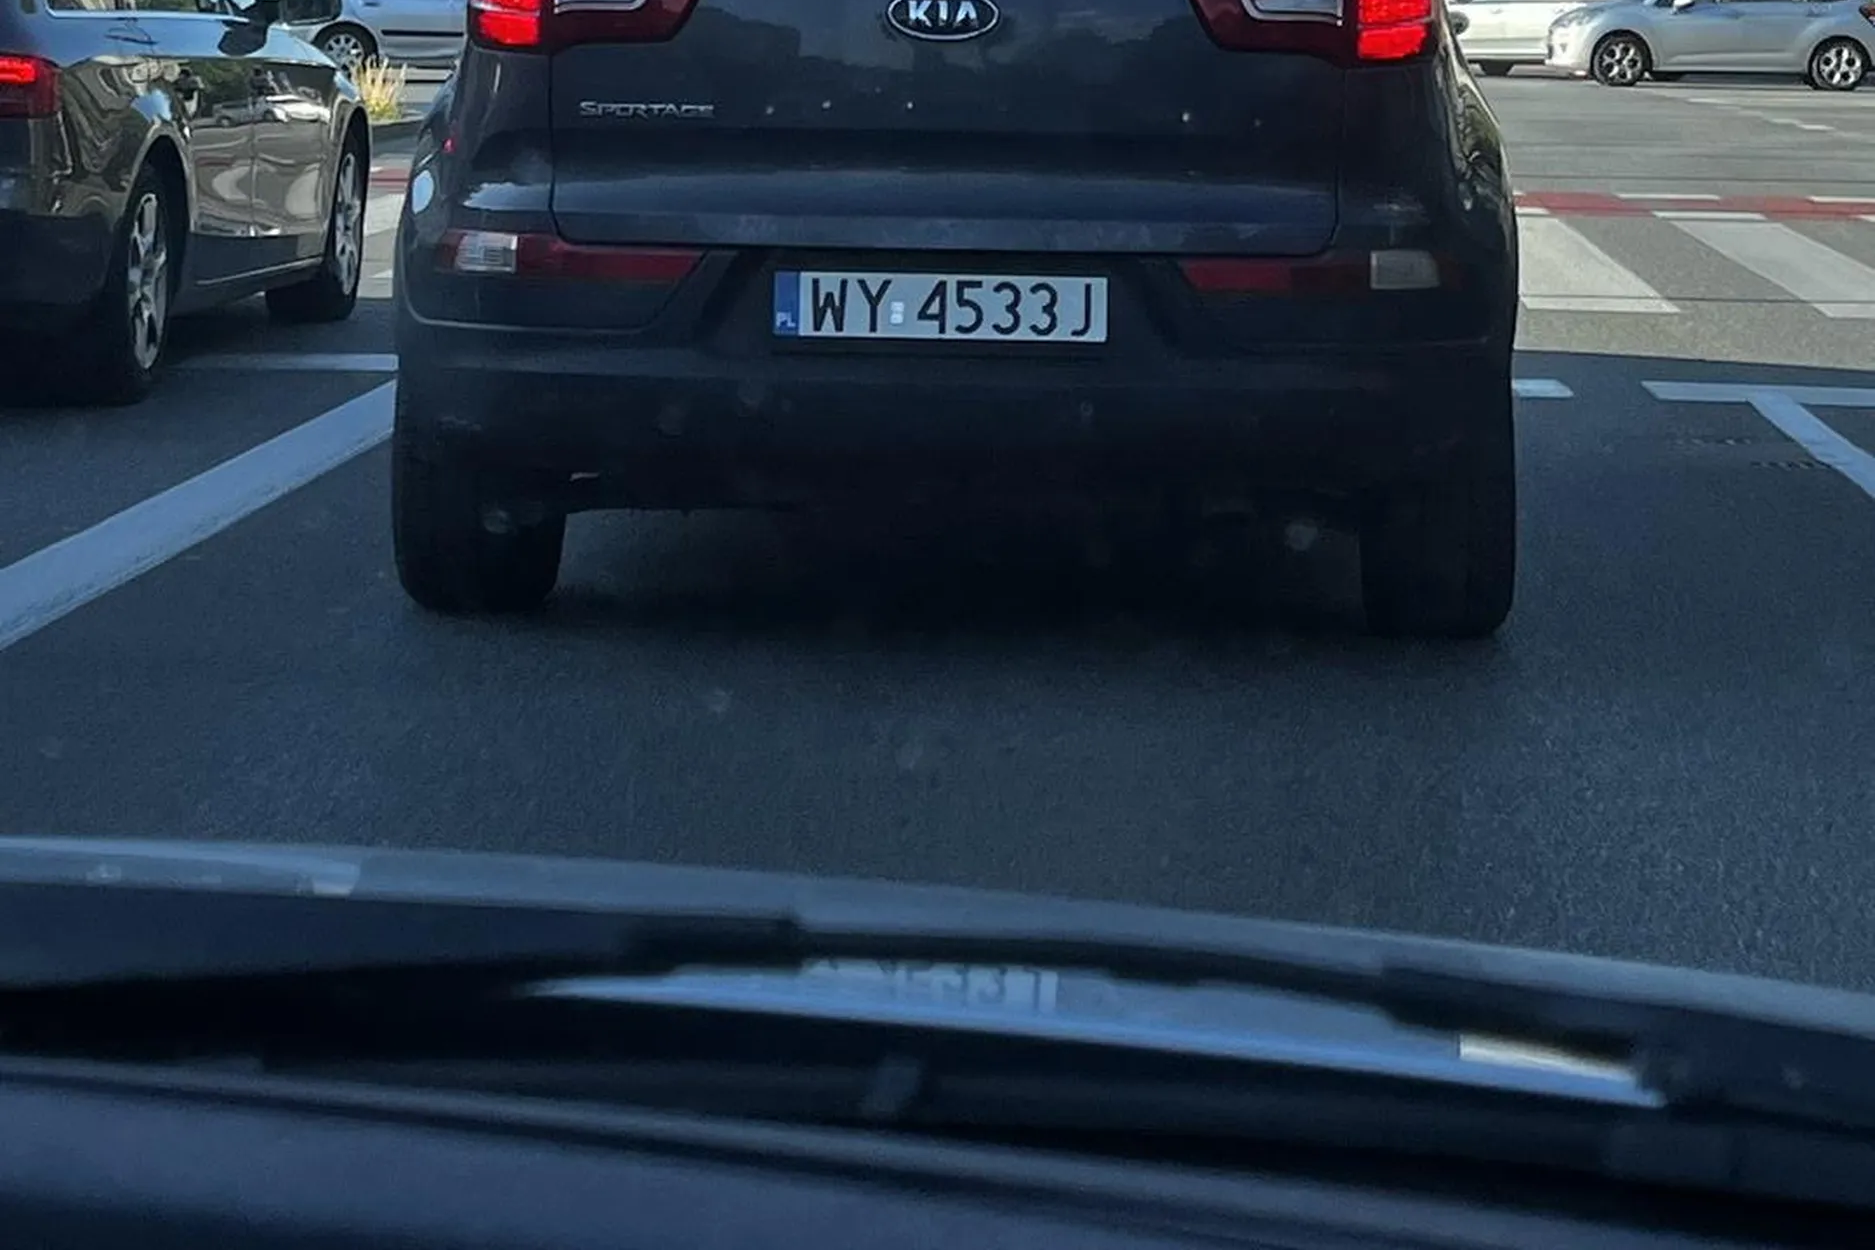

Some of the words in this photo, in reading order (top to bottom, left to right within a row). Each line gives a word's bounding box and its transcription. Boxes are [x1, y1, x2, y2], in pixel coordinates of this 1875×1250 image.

[907, 0, 979, 28] KIA
[775, 312, 797, 328] PL
[811, 277, 892, 333] WY
[916, 279, 1093, 337] 4533J
